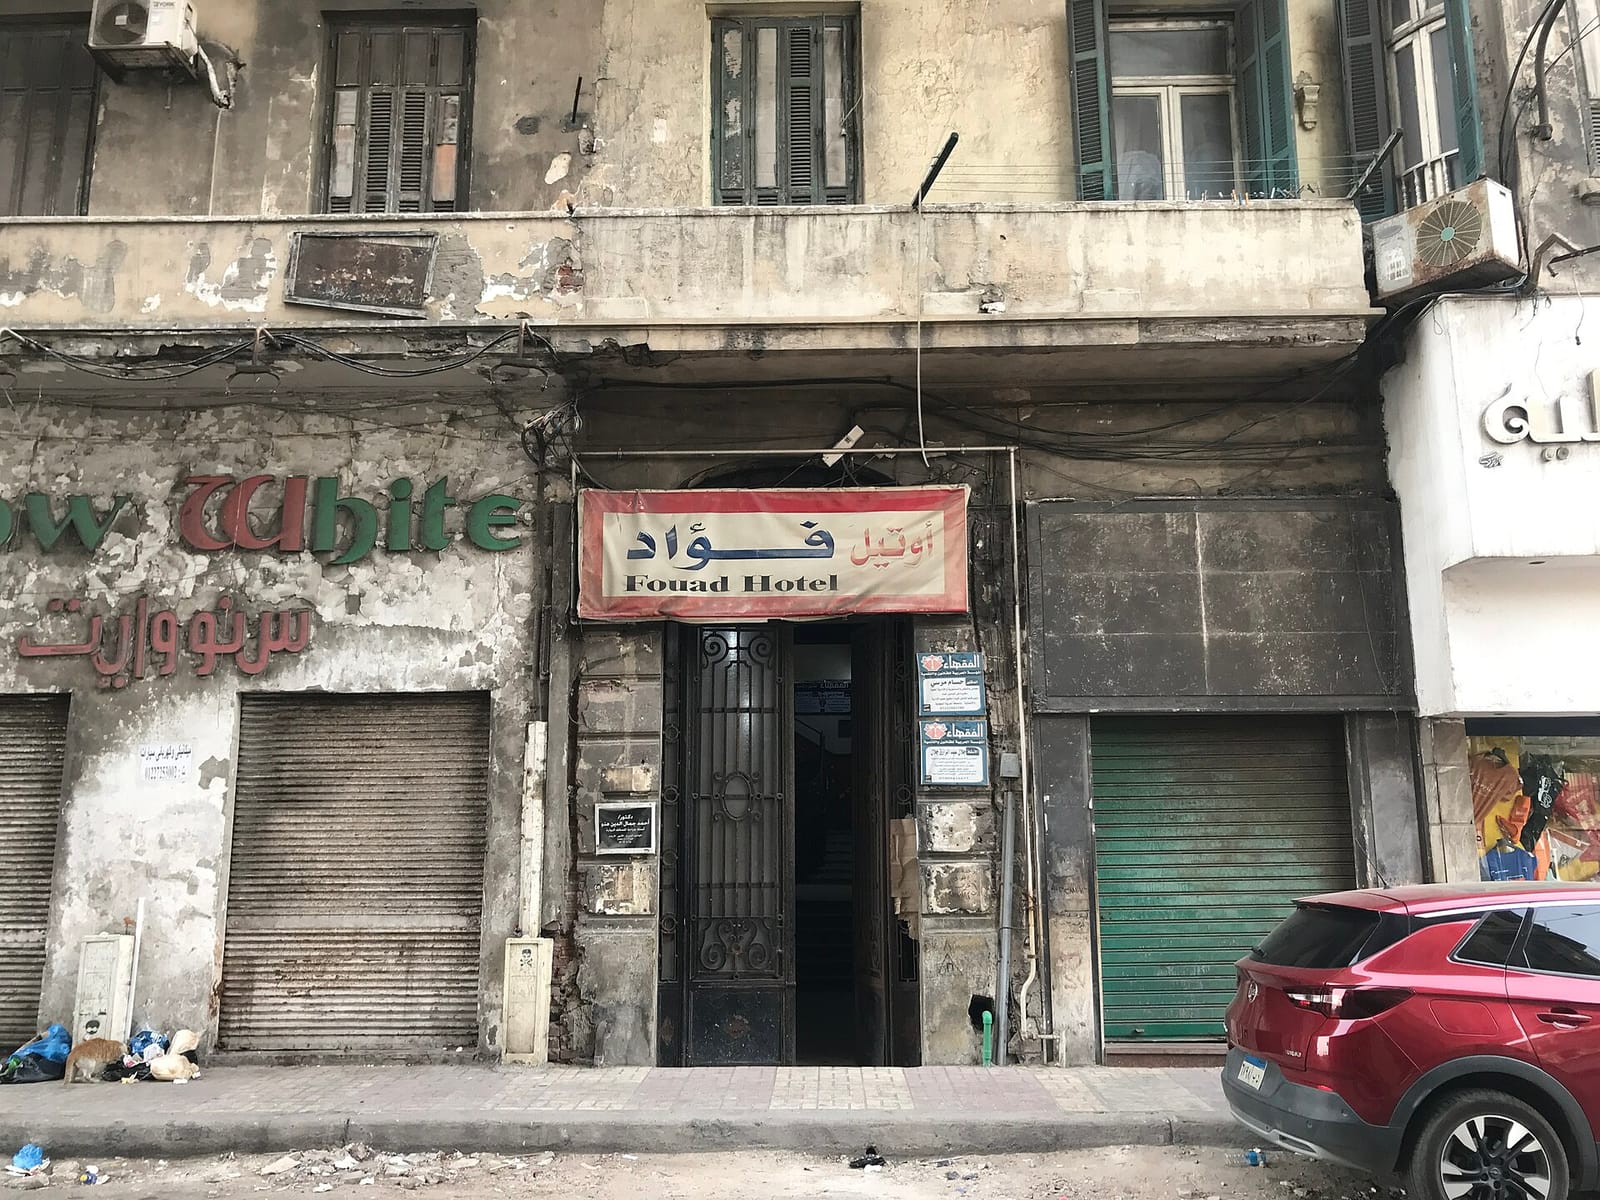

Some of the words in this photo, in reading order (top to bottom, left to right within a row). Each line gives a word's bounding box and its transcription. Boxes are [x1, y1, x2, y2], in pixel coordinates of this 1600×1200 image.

[180, 473, 523, 565] White
[626, 520, 835, 571] فؤاد
[850, 520, 935, 571] أوتيل
[623, 574, 730, 593] Fouad
[741, 573, 838, 592] Hotel
[943, 653, 980, 670] الفقهاء
[947, 722, 983, 738] الفقهاء
